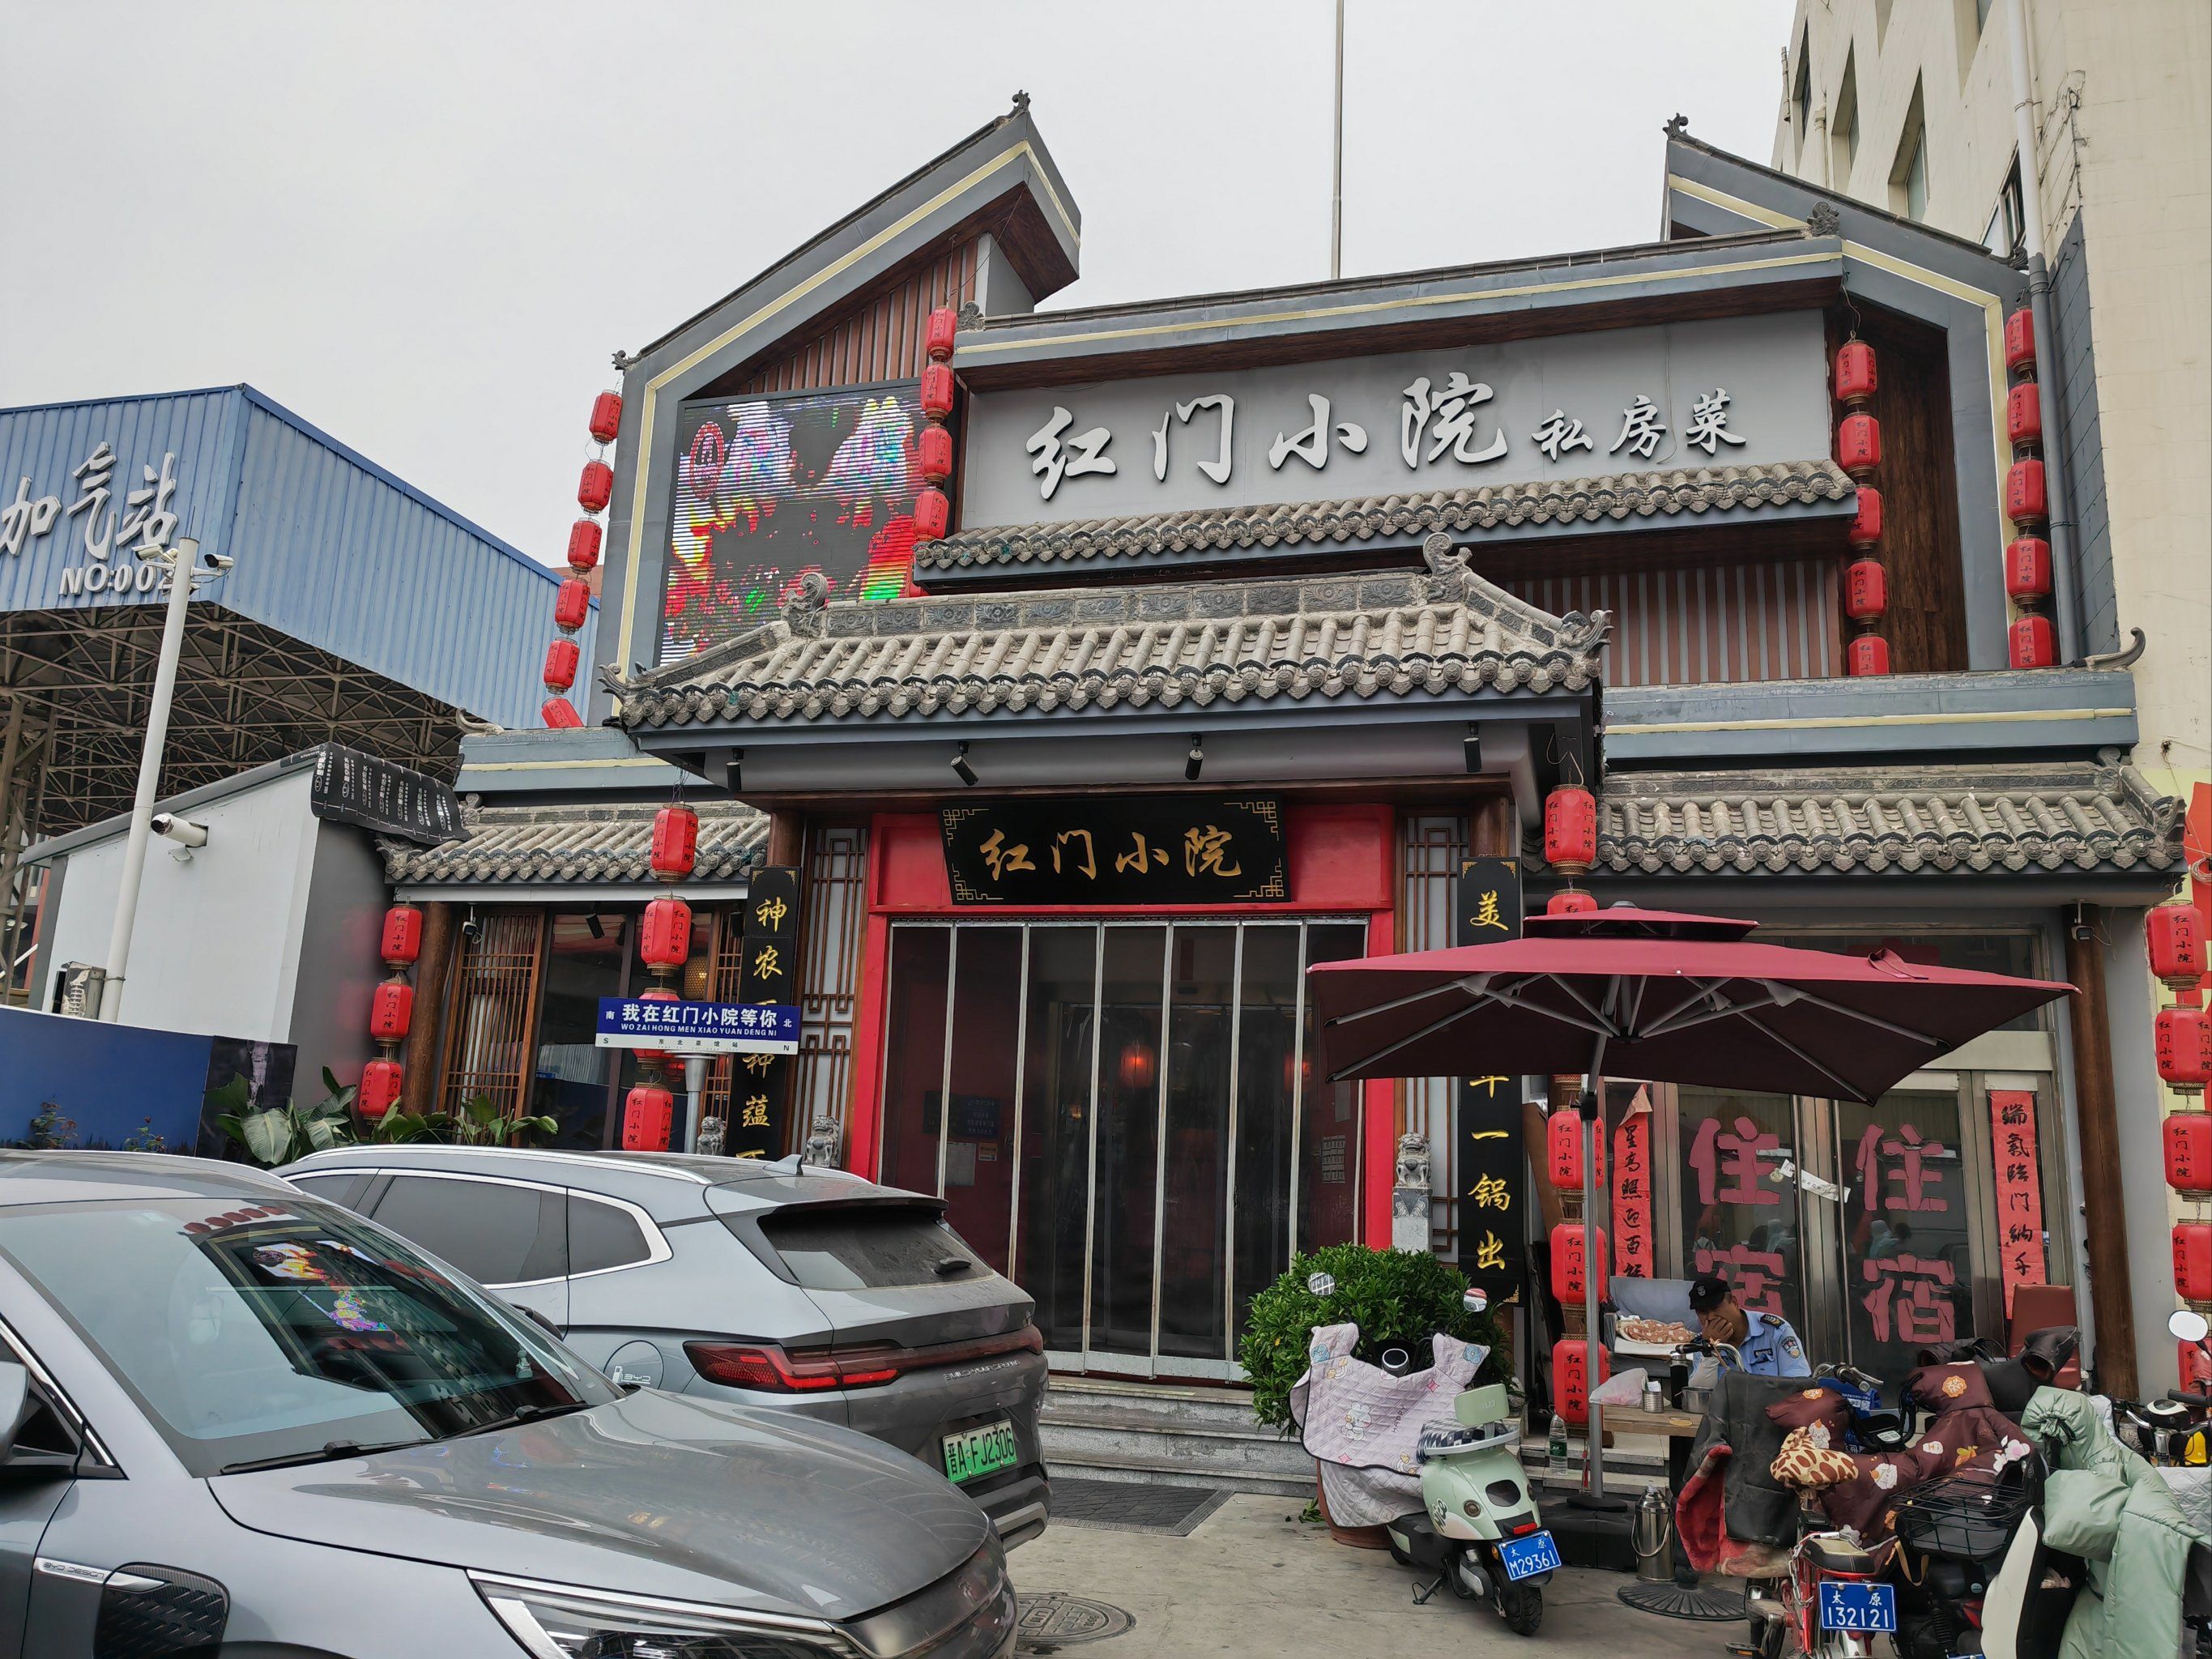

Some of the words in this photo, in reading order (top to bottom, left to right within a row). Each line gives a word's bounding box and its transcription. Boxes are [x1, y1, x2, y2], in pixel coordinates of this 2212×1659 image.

[1025, 372, 1508, 500] 红门小院
[1532, 387, 1747, 463] 私房菜
[0, 441, 178, 561] 加气站
[2019, 545, 2033, 583] 红门小院
[1853, 569, 1866, 605] 红门小院
[2019, 626, 2035, 664] 红门小院
[653, 817, 666, 859] 红门小院
[684, 819, 697, 863] 红门小院
[1548, 800, 1560, 850] 红门小院
[1583, 800, 1595, 851] 红门小院
[979, 825, 1242, 881] 红门小院
[392, 915, 408, 952] 红门小院
[671, 910, 686, 954] 红门小院
[2173, 915, 2193, 963] 红门小院
[383, 991, 399, 1030] 红门小院
[606, 1010, 615, 1021] 南
[622, 1004, 778, 1028] 我在红门小院等你
[783, 1018, 793, 1028] 北
[652, 1024, 676, 1033] HONG
[677, 1026, 697, 1034] MEN
[697, 1026, 718, 1034] XIAO
[719, 1027, 743, 1035] YUAN
[744, 1028, 767, 1036] DENG
[2158, 1021, 2174, 1069] 红门小院
[360, 1069, 373, 1108] 红门小院
[627, 1098, 643, 1144] 红门小院
[660, 1099, 672, 1146] 红门小院
[1558, 1124, 1573, 1177] 红门小院
[2172, 1127, 2191, 1178] 红门小院
[1856, 1123, 1955, 1343] 住宿
[1567, 1236, 1583, 1293] 红门小院
[2174, 1236, 2189, 1288] 红门小院
[624, 1373, 651, 1382] BYD
[1566, 1354, 1583, 1411] 红门小院
[1392, 1405, 1409, 1434] HAPPY
[43, 1562, 65, 1572] BYD
[66, 1566, 104, 1580] DESIGN
[1508, 1550, 1556, 1577] M29361
[1828, 1606, 1889, 1628] 132121
[1831, 1590, 1882, 1606] 太原
